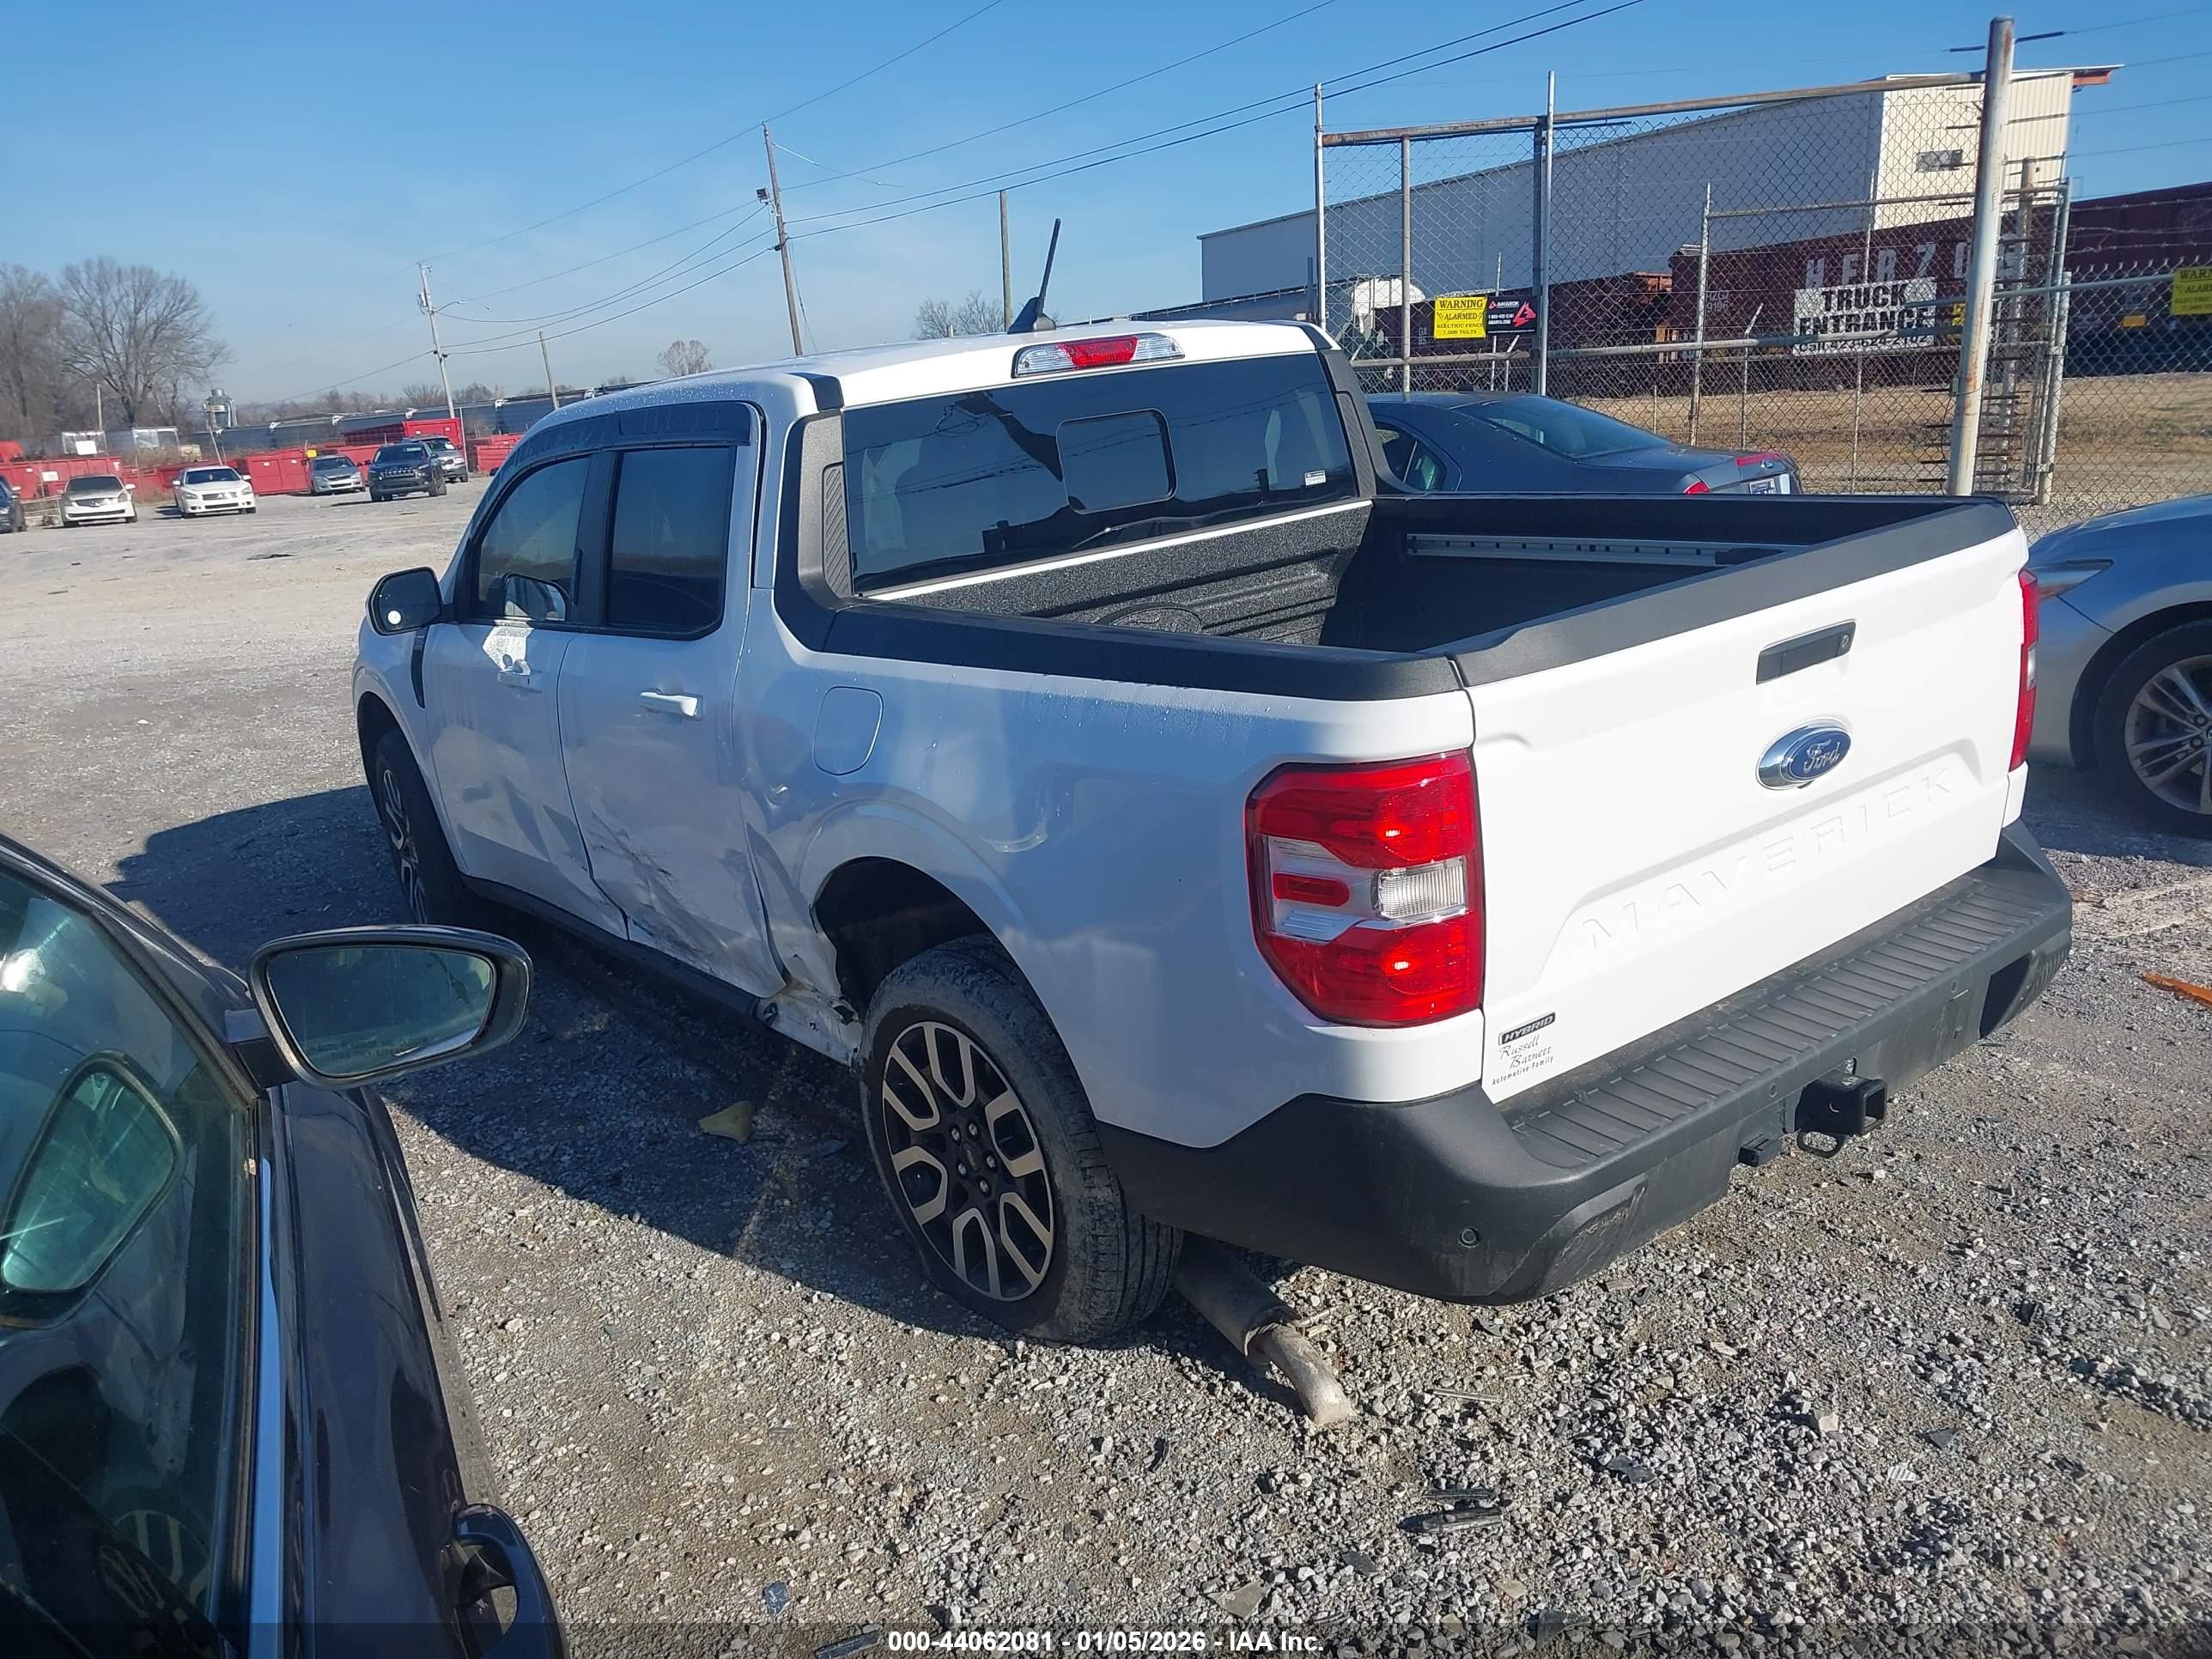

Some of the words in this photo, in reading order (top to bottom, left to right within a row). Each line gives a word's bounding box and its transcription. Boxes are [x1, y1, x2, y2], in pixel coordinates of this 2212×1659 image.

[1439, 300, 1483, 309] WARNING
[1821, 283, 1908, 312] TRUCK
[1799, 307, 1931, 336] ENTRANCE
[1803, 739, 1841, 773] Ford
[1583, 768, 1951, 950] MAVERICK
[1504, 1015, 1553, 1042] HYBRID
[1498, 1035, 1540, 1060] Russell
[1510, 1047, 1552, 1068] Barnett
[1492, 1066, 1529, 1085] Automotive
[1532, 1055, 1553, 1069] Family
